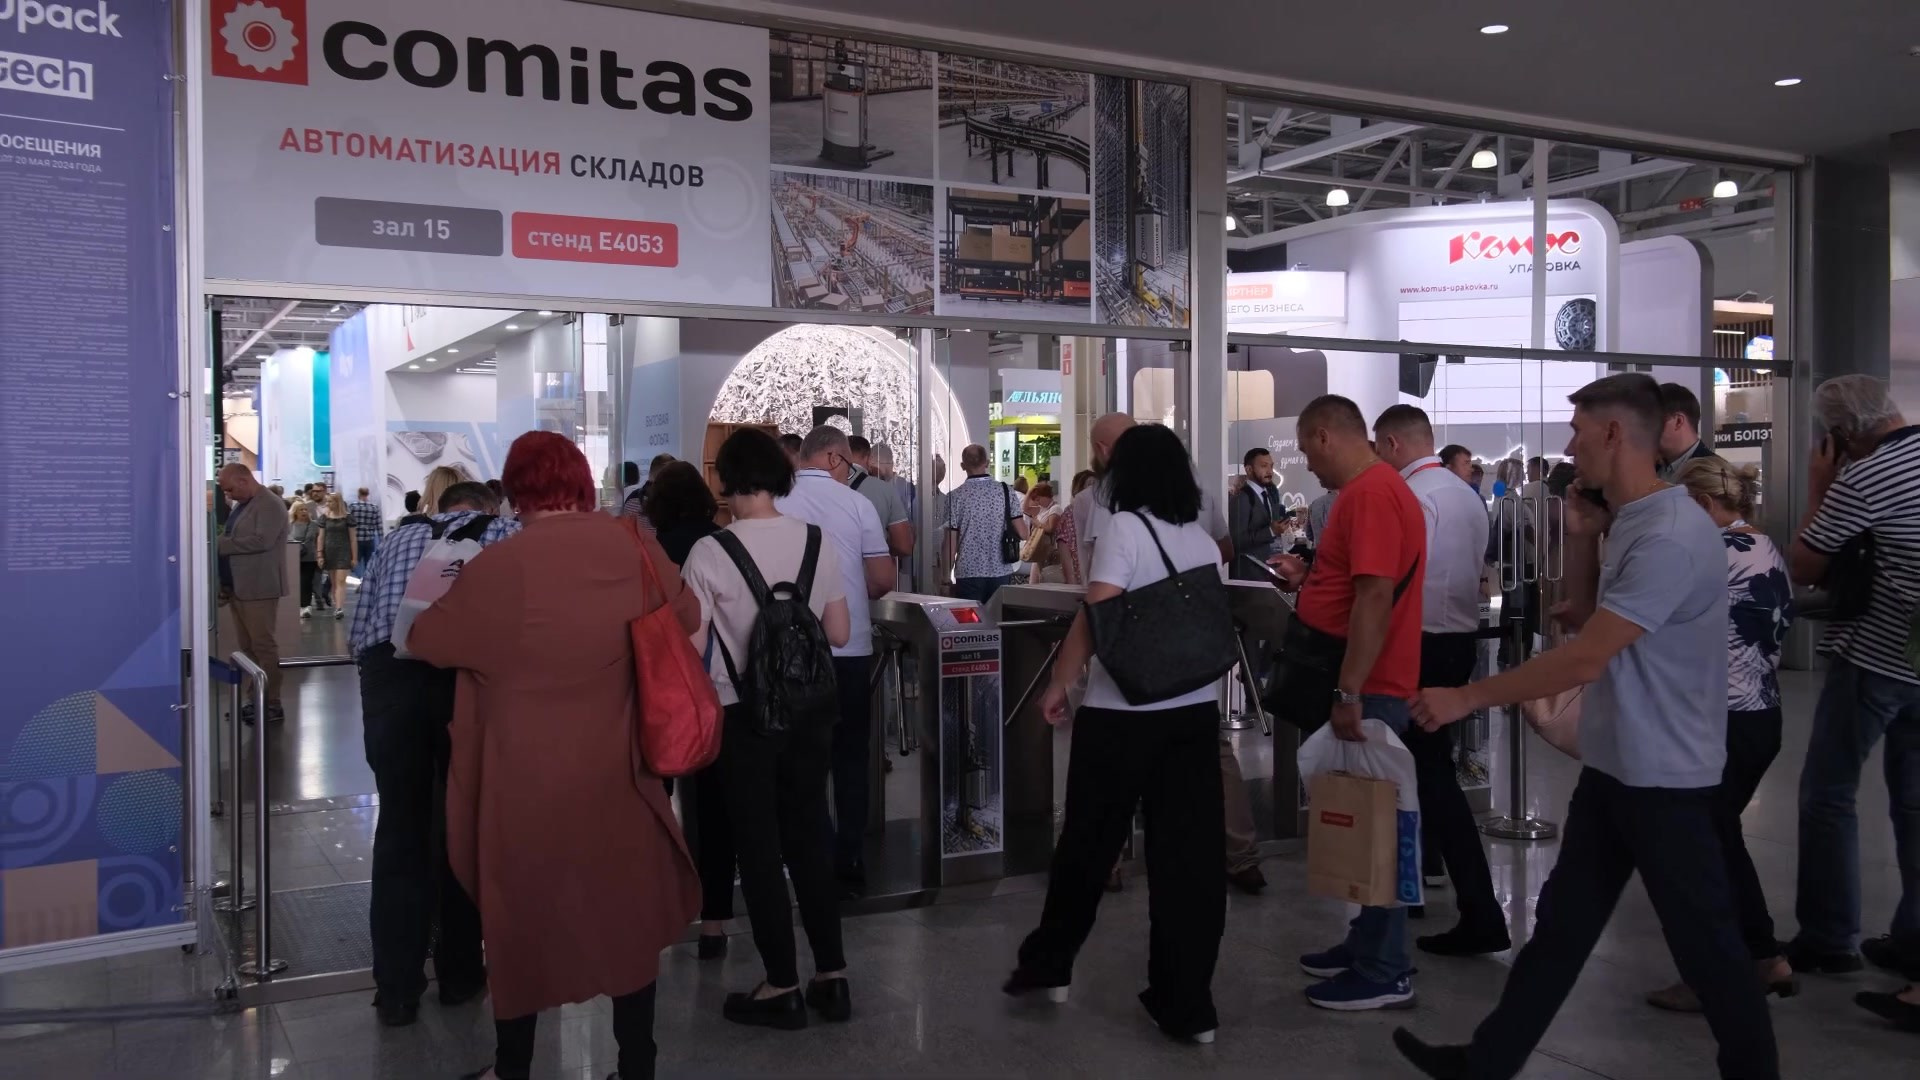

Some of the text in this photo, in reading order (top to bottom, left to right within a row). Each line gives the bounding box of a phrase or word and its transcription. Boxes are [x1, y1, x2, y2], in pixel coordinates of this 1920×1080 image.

[322, 20, 753, 122] comitas
[28, 157, 50, 167] МАЯ
[52, 160, 74, 170] 2024
[76, 163, 102, 173] ГОДА
[279, 128, 705, 189] АВТОМАТИЗАЦИЯ СКЛАДОВ
[372, 219, 450, 240] зал 15
[527, 231, 664, 255] стенд E4053
[1509, 261, 1581, 274] УПАОВКА
[1400, 283, 1498, 294] www.komus-upakovka.ru
[1254, 303, 1305, 313] БИЗНЕСА
[954, 634, 999, 643] comitas
